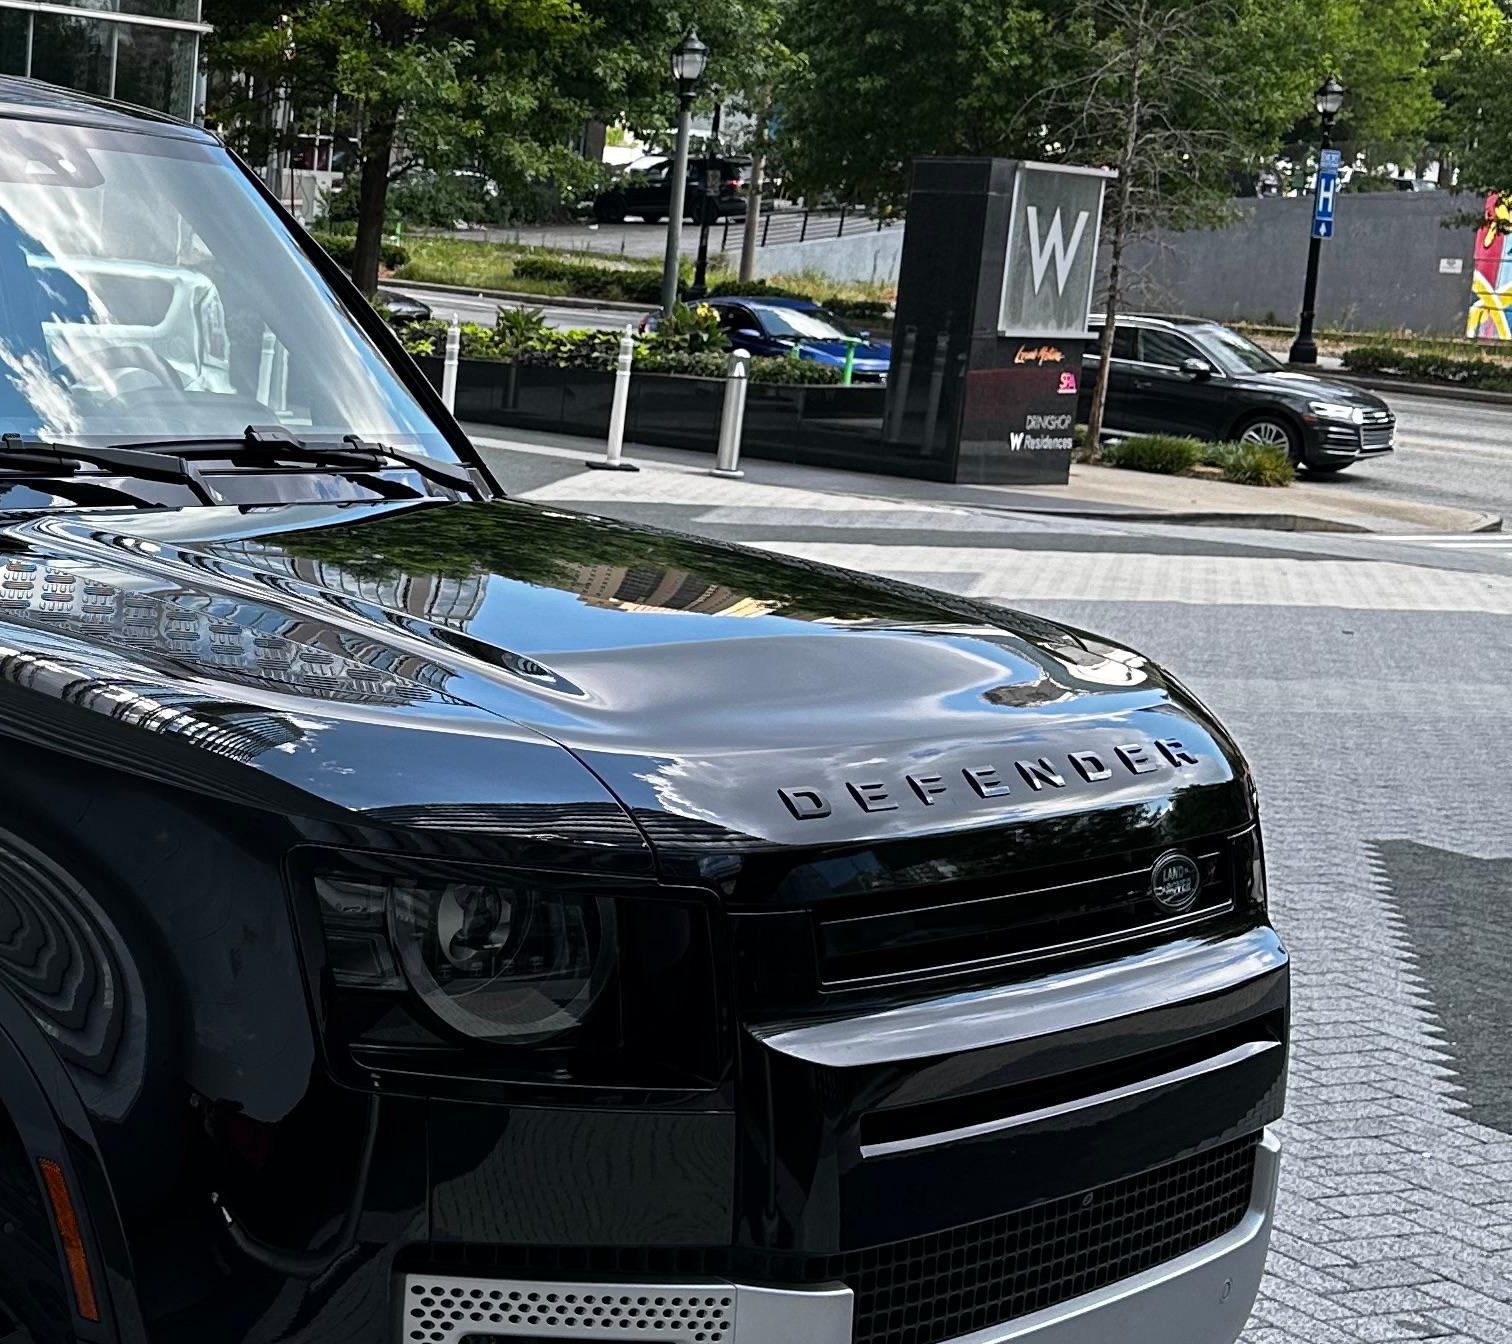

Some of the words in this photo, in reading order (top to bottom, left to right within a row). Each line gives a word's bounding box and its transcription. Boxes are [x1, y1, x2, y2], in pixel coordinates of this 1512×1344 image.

[1318, 178, 1335, 213] H
[1026, 206, 1090, 297] W
[1010, 432, 1024, 451] W
[1024, 434, 1073, 450] Residences
[777, 737, 1199, 821] DEFENDER
[1163, 865, 1184, 882] LAND
